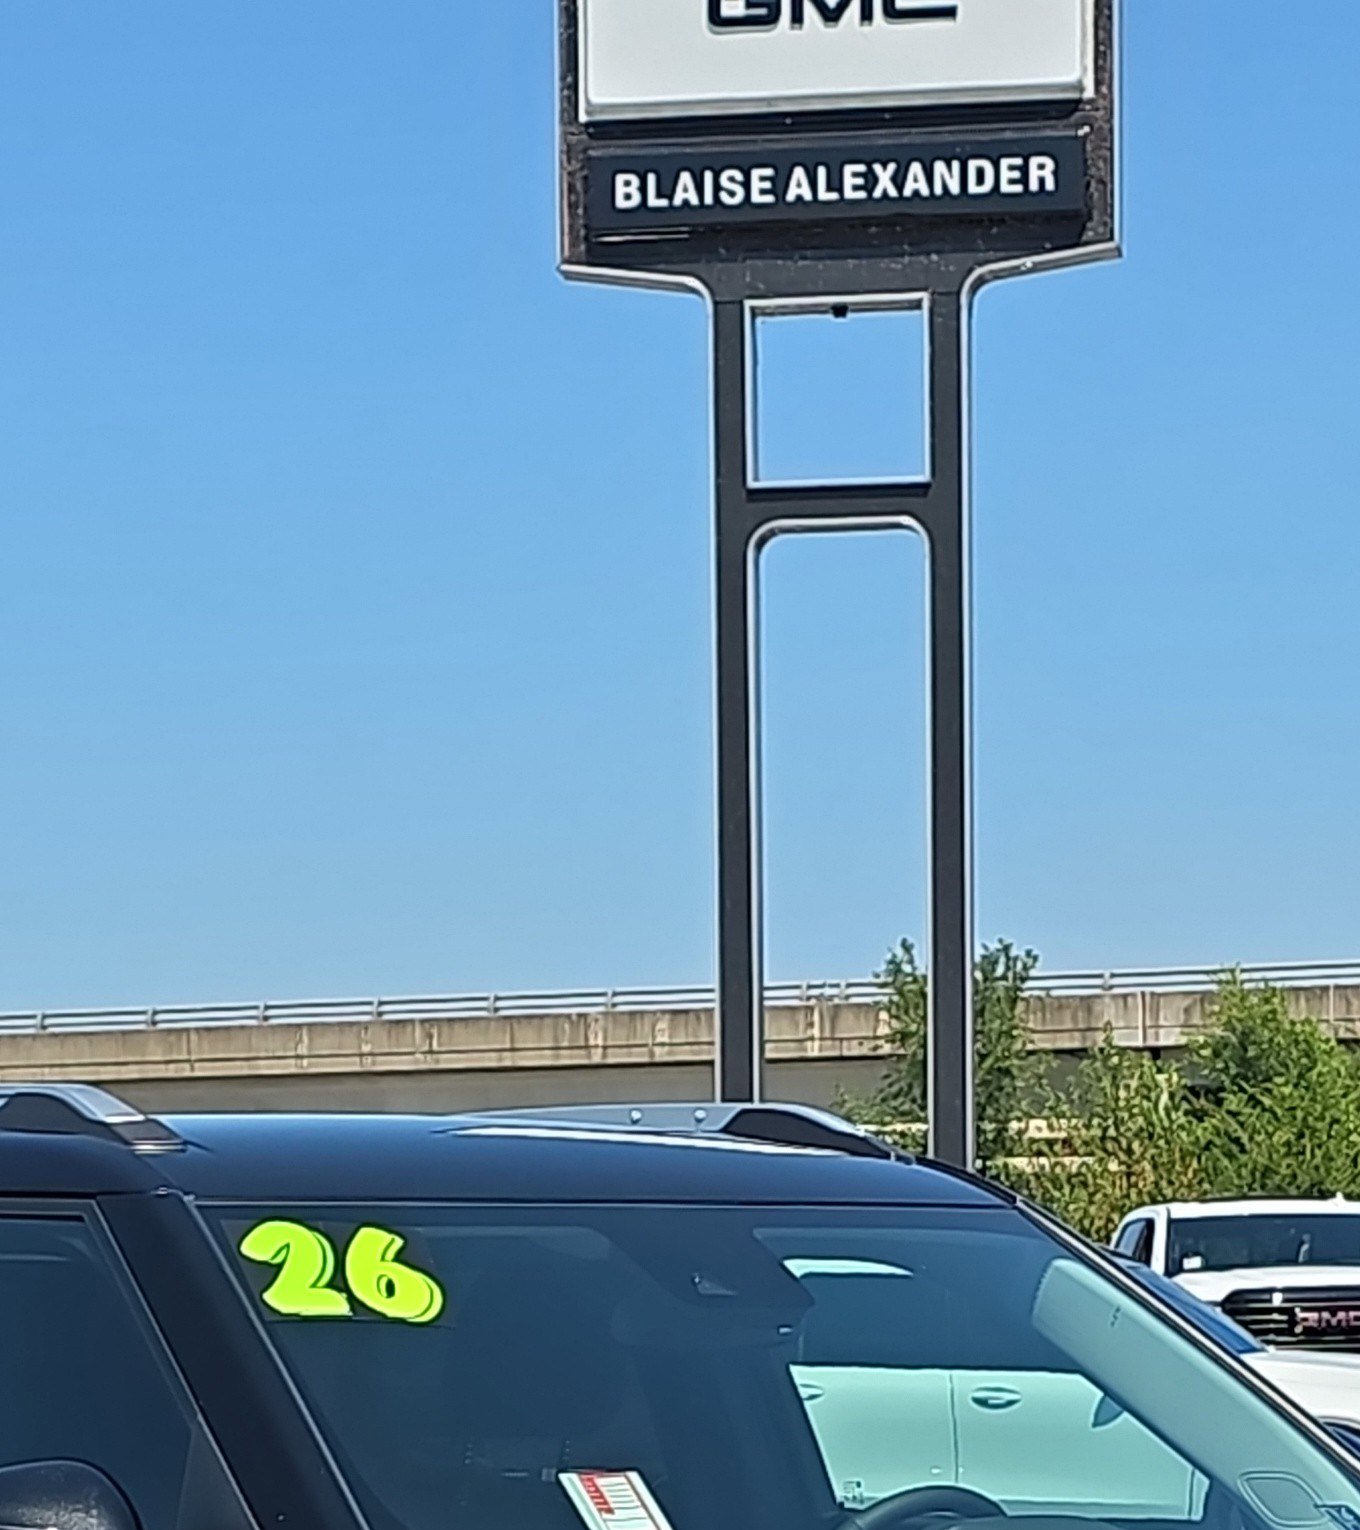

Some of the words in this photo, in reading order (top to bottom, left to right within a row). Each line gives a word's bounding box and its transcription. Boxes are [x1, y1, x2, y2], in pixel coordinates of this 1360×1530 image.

[613, 167, 775, 211] BLAISE
[785, 155, 1058, 202] ALEXANDER
[239, 1219, 444, 1326] 26
